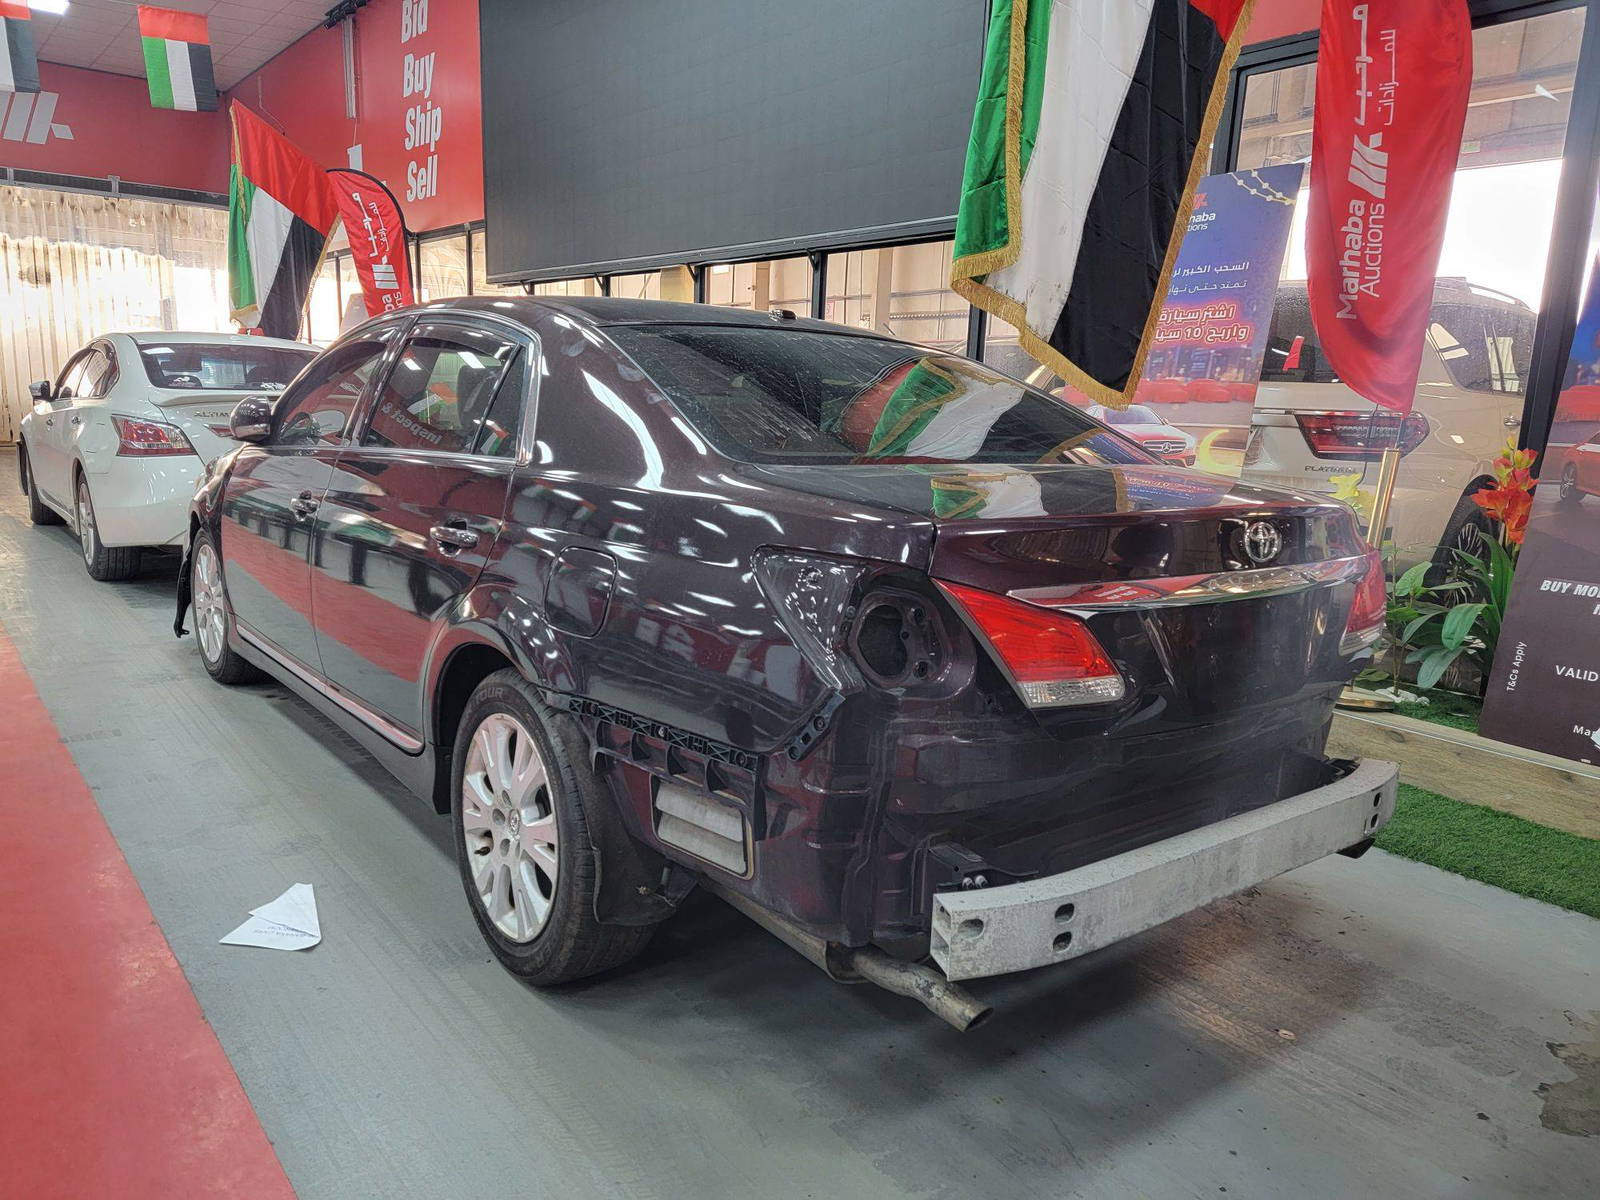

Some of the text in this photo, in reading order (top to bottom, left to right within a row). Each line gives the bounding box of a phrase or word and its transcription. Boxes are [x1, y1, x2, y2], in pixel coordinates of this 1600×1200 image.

[401, 0, 429, 44] Bid
[403, 52, 436, 98] Buy
[404, 101, 442, 152] Ship
[406, 154, 438, 203] Sell
[1359, 202, 1386, 299] Auctions
[1214, 261, 1250, 275] السحب
[1336, 199, 1367, 321] Marhaba
[1182, 264, 1212, 277] الكبير
[1188, 283, 1218, 294] حتى
[1220, 279, 1248, 290] تمتد
[1159, 308, 1200, 325] سيارة
[1184, 326, 1203, 340] 10
[1206, 324, 1250, 343] واربح
[1540, 579, 1572, 594] BUY
[1506, 641, 1528, 692] T&Cs Apply
[1555, 664, 1599, 682] VALID
